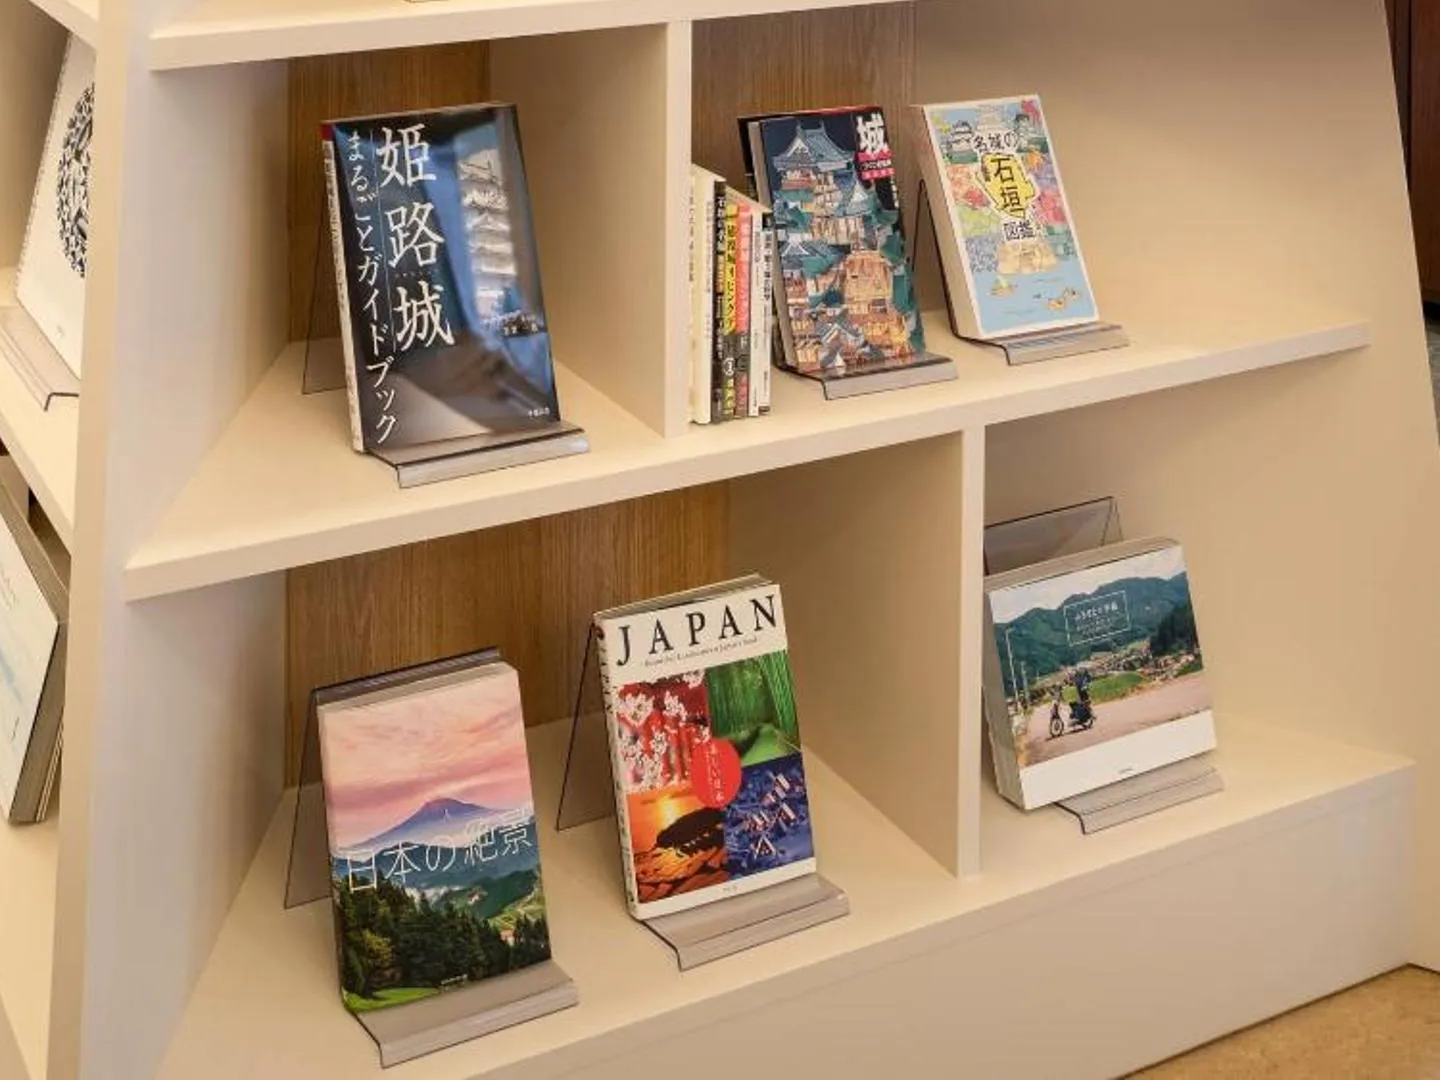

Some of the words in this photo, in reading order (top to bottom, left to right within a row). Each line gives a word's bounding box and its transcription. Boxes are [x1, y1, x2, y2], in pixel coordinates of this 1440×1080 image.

[990, 157, 1025, 213] 石垣
[375, 123, 455, 352] 姫路城
[346, 133, 399, 445] まるごとガイドブック
[616, 594, 777, 667] JAPAN
[347, 808, 534, 894] 日本の絶景
